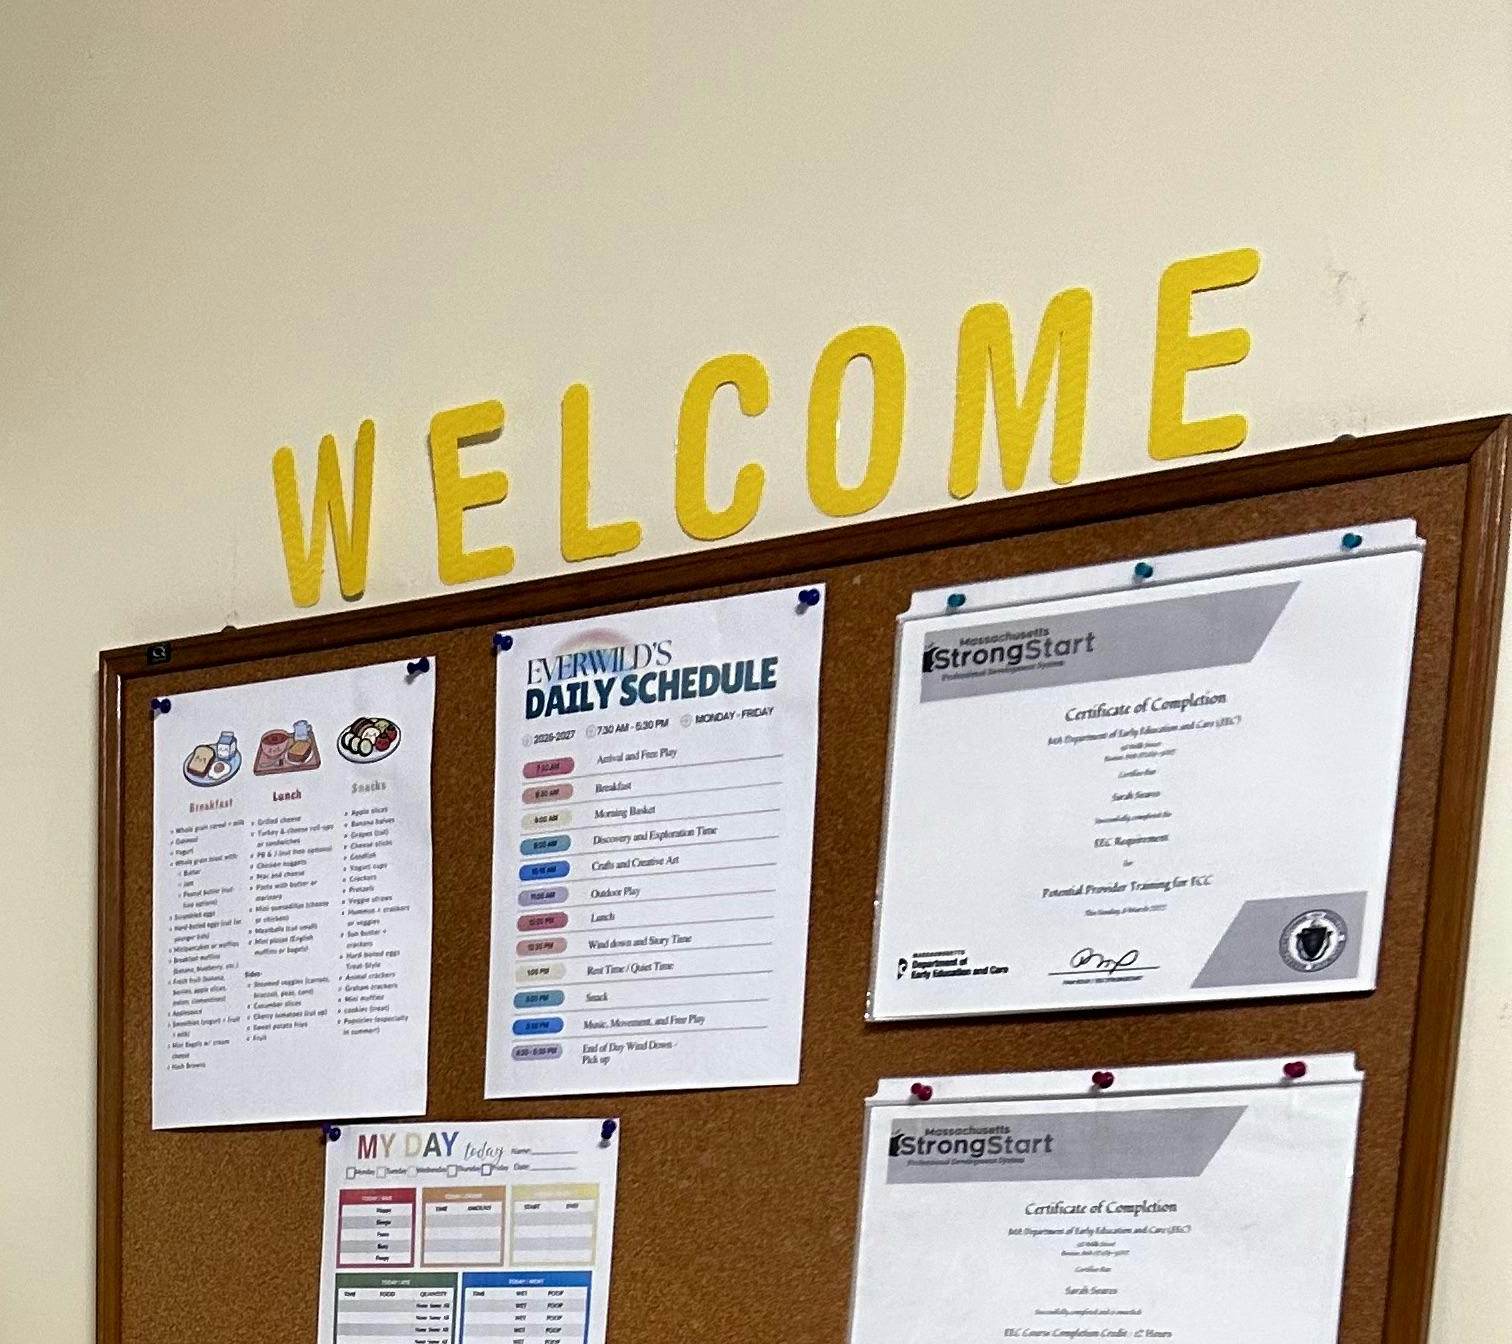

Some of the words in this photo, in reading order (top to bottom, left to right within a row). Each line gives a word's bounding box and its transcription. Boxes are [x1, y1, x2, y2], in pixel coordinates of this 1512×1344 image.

[271, 245, 1261, 608] WELCOME
[960, 628, 1049, 646] Massachusetts
[935, 631, 1095, 669] StrongStart
[527, 640, 672, 685] EVERWILD'S
[525, 677, 615, 720] DAILY
[619, 656, 779, 707] SCHEDULE
[1066, 703, 1131, 722] Certificate
[1134, 697, 1147, 714] of
[1151, 692, 1226, 712] Completion
[696, 711, 735, 724] MONDAY
[742, 707, 774, 719] FRIDAY
[615, 723, 629, 734] AM
[655, 719, 668, 729] PM
[1065, 733, 1108, 745] Department
[1119, 728, 1138, 738] Early
[1140, 724, 1178, 735] Education
[1181, 722, 1195, 730] and
[1197, 721, 1214, 729] Care
[597, 752, 623, 764] Arrival
[625, 751, 638, 762] and
[640, 749, 658, 761] Free
[660, 748, 677, 760] Play
[352, 780, 386, 793] Snacks
[596, 782, 631, 793] Breakfast
[273, 789, 301, 801] Lunch
[190, 799, 233, 812] Breakfast
[595, 808, 627, 819] Morning
[630, 805, 655, 815] Basket
[593, 833, 631, 845] Discovery
[633, 832, 648, 841] and
[650, 827, 694, 841] Exploration
[696, 826, 717, 835] Time
[1115, 834, 1169, 847] Requirement
[592, 860, 615, 871] Crafts
[616, 859, 630, 869] and
[632, 857, 664, 868] Creative
[666, 856, 679, 865] Art
[591, 888, 621, 898] Outdoor
[624, 887, 640, 897] Play
[1042, 884, 1083, 898] Potential
[1086, 882, 1127, 895] Provider
[1131, 881, 1170, 892] Training
[1173, 876, 1187, 888] for
[591, 912, 615, 922] Lunch
[589, 940, 608, 949] Wind
[610, 939, 631, 948] down
[633, 937, 647, 947] and
[649, 936, 669, 946] Story
[672, 934, 692, 943] Time
[587, 966, 604, 976] Rest
[606, 965, 626, 974] Time
[631, 963, 652, 974] Quiet
[654, 962, 674, 971] Time
[912, 958, 957, 969] Department
[959, 958, 967, 966] of
[911, 970, 930, 980] Early
[932, 968, 971, 978] Education
[973, 967, 988, 975] and
[990, 966, 1009, 974] Care
[586, 993, 607, 1002] Snack
[655, 1017, 669, 1025] and
[670, 1015, 686, 1025] Free
[688, 1014, 705, 1025] Play
[583, 1044, 597, 1053] End
[599, 1043, 607, 1052] of
[609, 1043, 624, 1053] Day
[626, 1041, 647, 1051] Wind
[649, 1040, 672, 1050] Down
[582, 1054, 597, 1065] Pick
[600, 1056, 610, 1065] up
[925, 1125, 1010, 1136] Massachusetts
[358, 1132, 396, 1159] MY
[405, 1131, 458, 1157] DAY
[464, 1141, 504, 1165] today
[901, 1134, 1054, 1158] StrongStart
[1025, 1201, 1086, 1215] Certificate
[1090, 1201, 1104, 1214] of
[1106, 1201, 1177, 1217] Completion
[1024, 1227, 1064, 1236] Department
[1075, 1227, 1094, 1236] Early
[1022, 1328, 1050, 1337] Course
[1052, 1328, 1099, 1340] Completion
[1101, 1328, 1126, 1337] Credit
[1146, 1329, 1172, 1337] Hours
